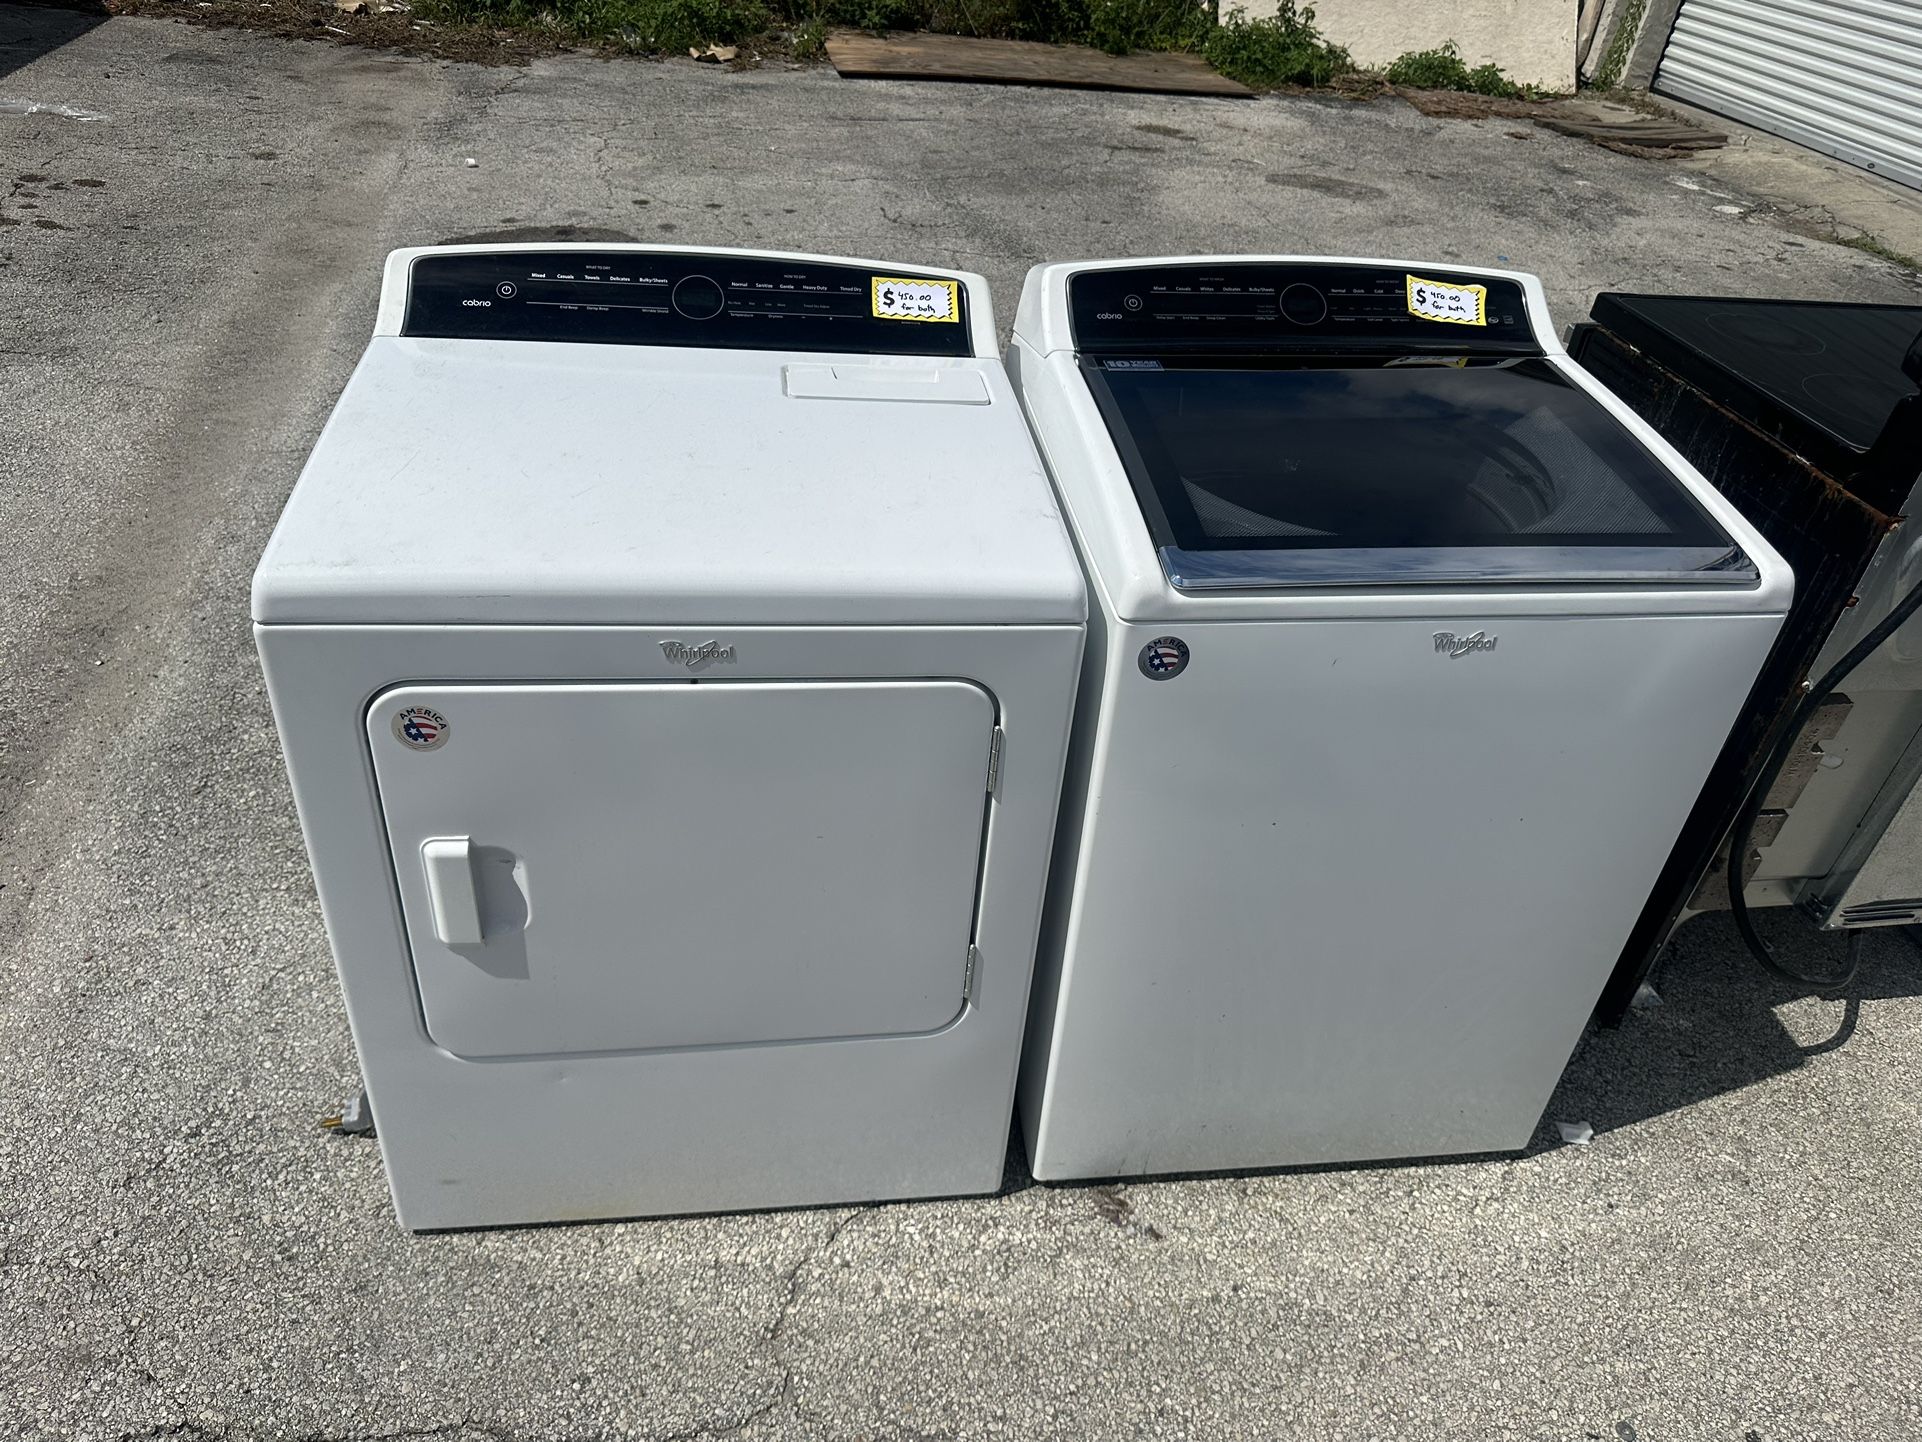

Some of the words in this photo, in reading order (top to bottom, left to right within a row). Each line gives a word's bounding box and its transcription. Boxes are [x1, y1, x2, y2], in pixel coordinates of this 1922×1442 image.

[609, 275, 631, 283] Delicates
[462, 299, 492, 308] cabrio
[883, 287, 896, 308] $
[898, 291, 932, 301] 450.00
[1416, 287, 1427, 306] $
[917, 304, 936, 313] both
[1431, 301, 1444, 310] for
[1448, 305, 1467, 313] both
[1107, 360, 1130, 368] 10
[660, 641, 735, 664] Whirlpool
[1147, 639, 1187, 658] AMERICA
[1433, 631, 1498, 655] Whirlpool
[400, 708, 447, 730] AMERICA
